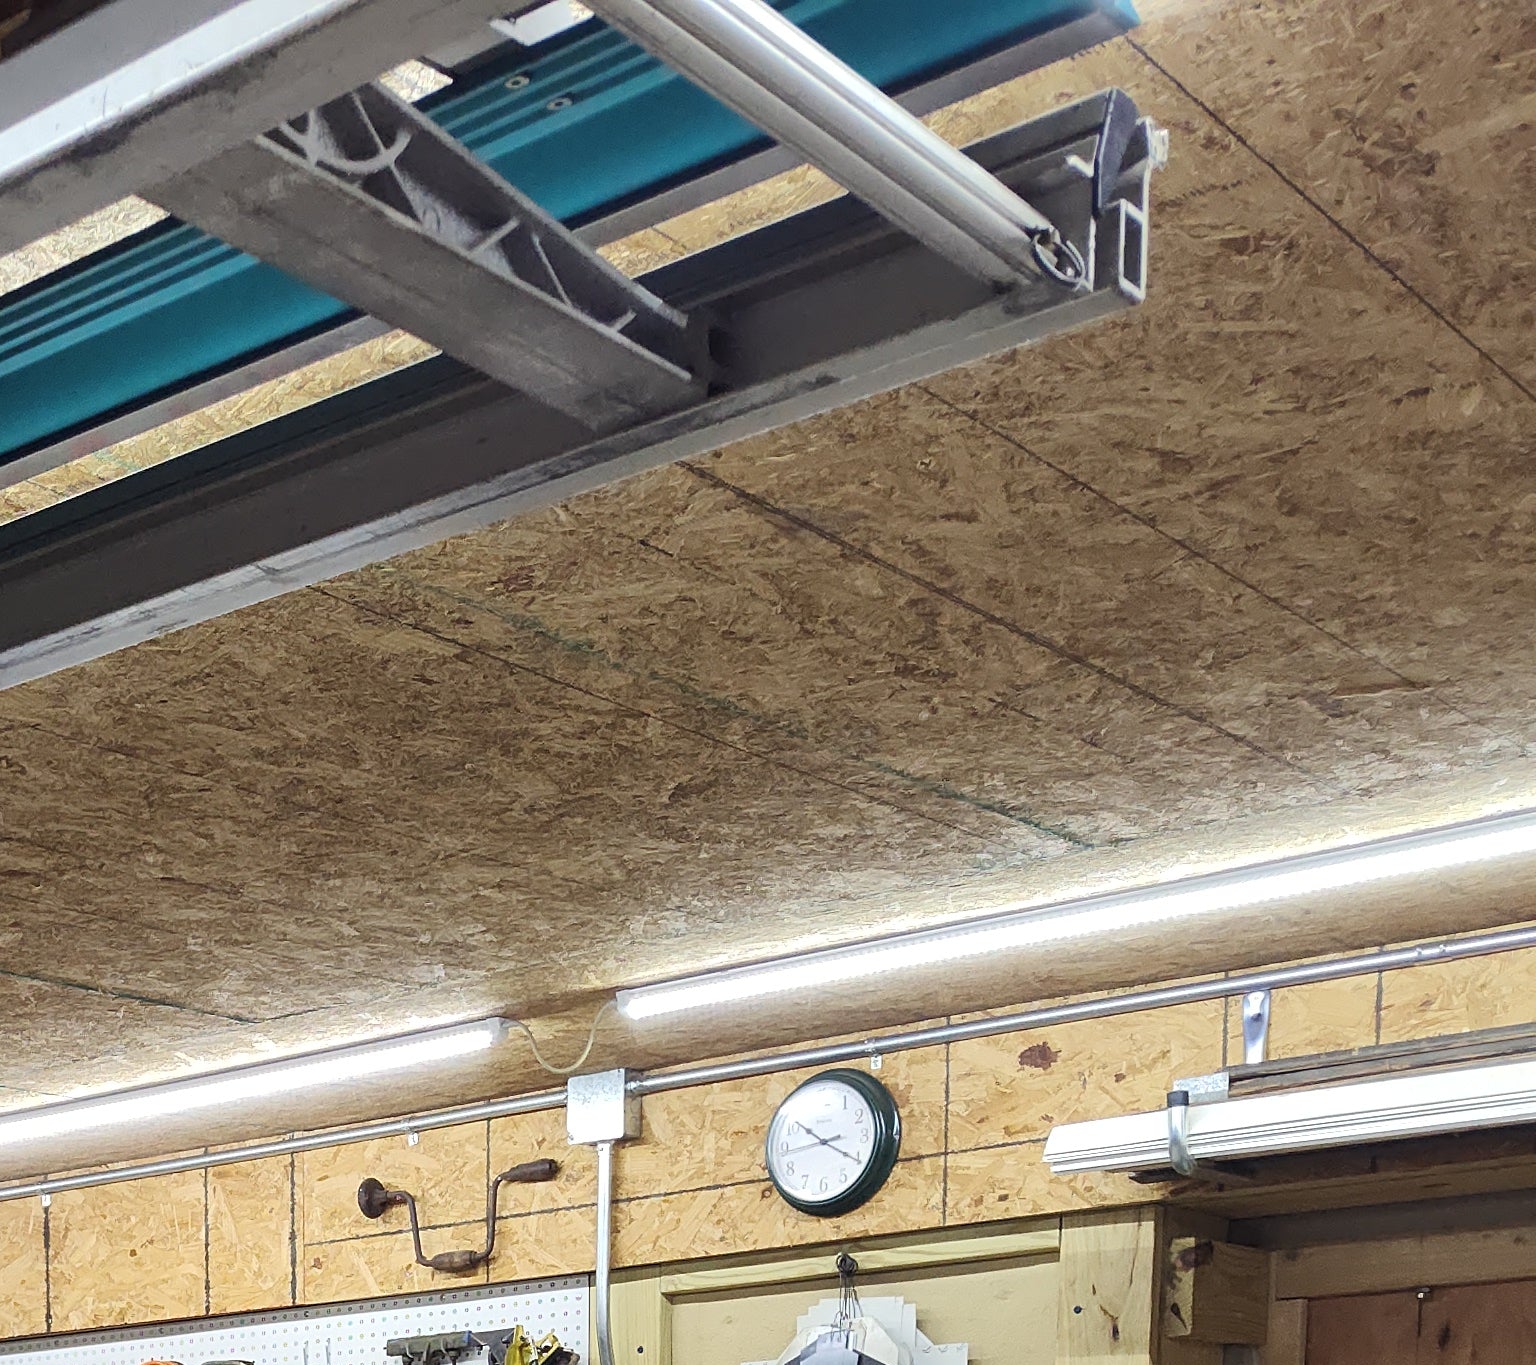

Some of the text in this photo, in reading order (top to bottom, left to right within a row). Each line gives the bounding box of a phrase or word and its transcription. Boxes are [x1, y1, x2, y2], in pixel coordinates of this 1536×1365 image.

[854, 1108, 864, 1124] 2
[860, 1128, 869, 1144] 3
[786, 1161, 795, 1176] 8
[839, 1168, 848, 1183] 5
[801, 1174, 810, 1190] 7
[819, 1176, 828, 1192] 6
